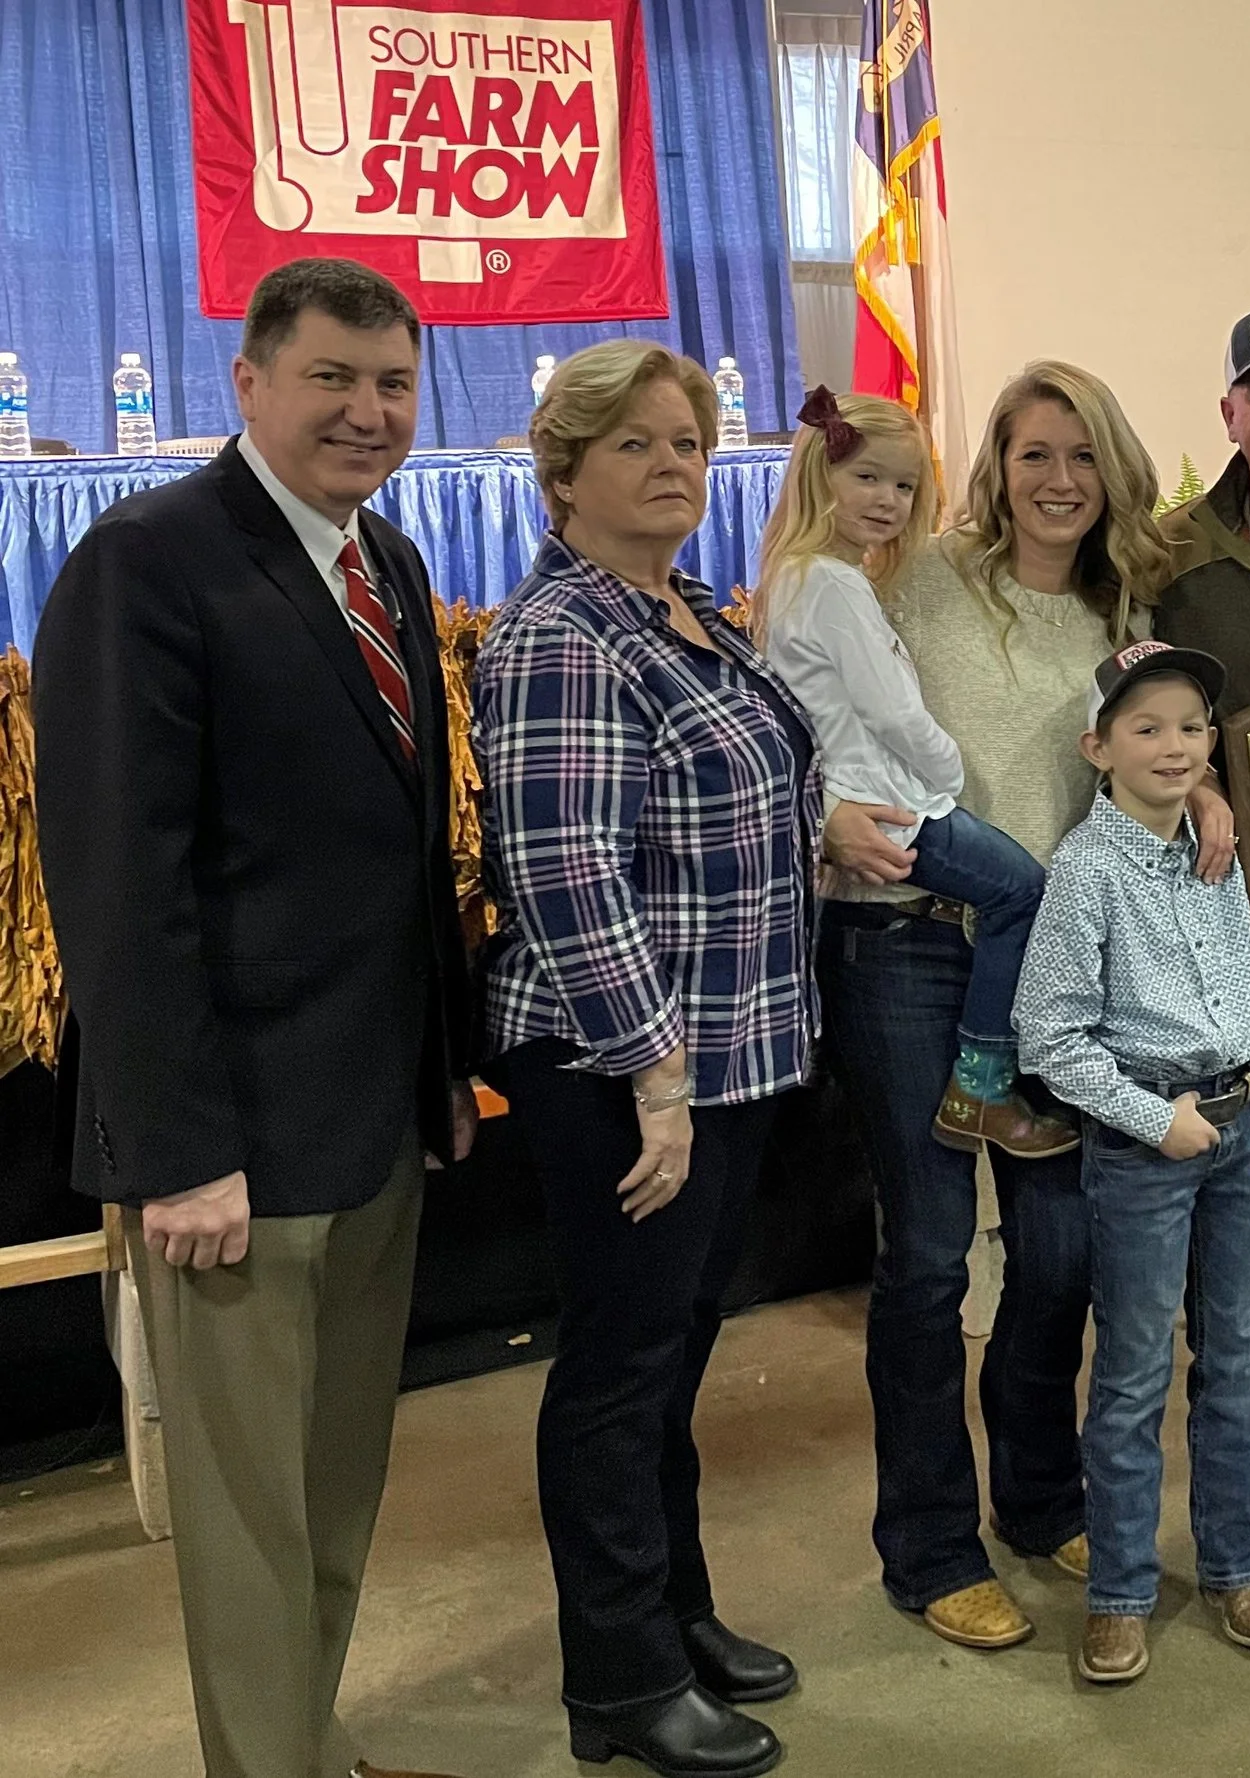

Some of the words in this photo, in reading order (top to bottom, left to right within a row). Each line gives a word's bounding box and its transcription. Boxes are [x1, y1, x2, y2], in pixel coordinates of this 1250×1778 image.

[368, 25, 593, 74] SOUTHERN
[369, 69, 600, 148] FARM
[355, 144, 600, 219] SHOW
